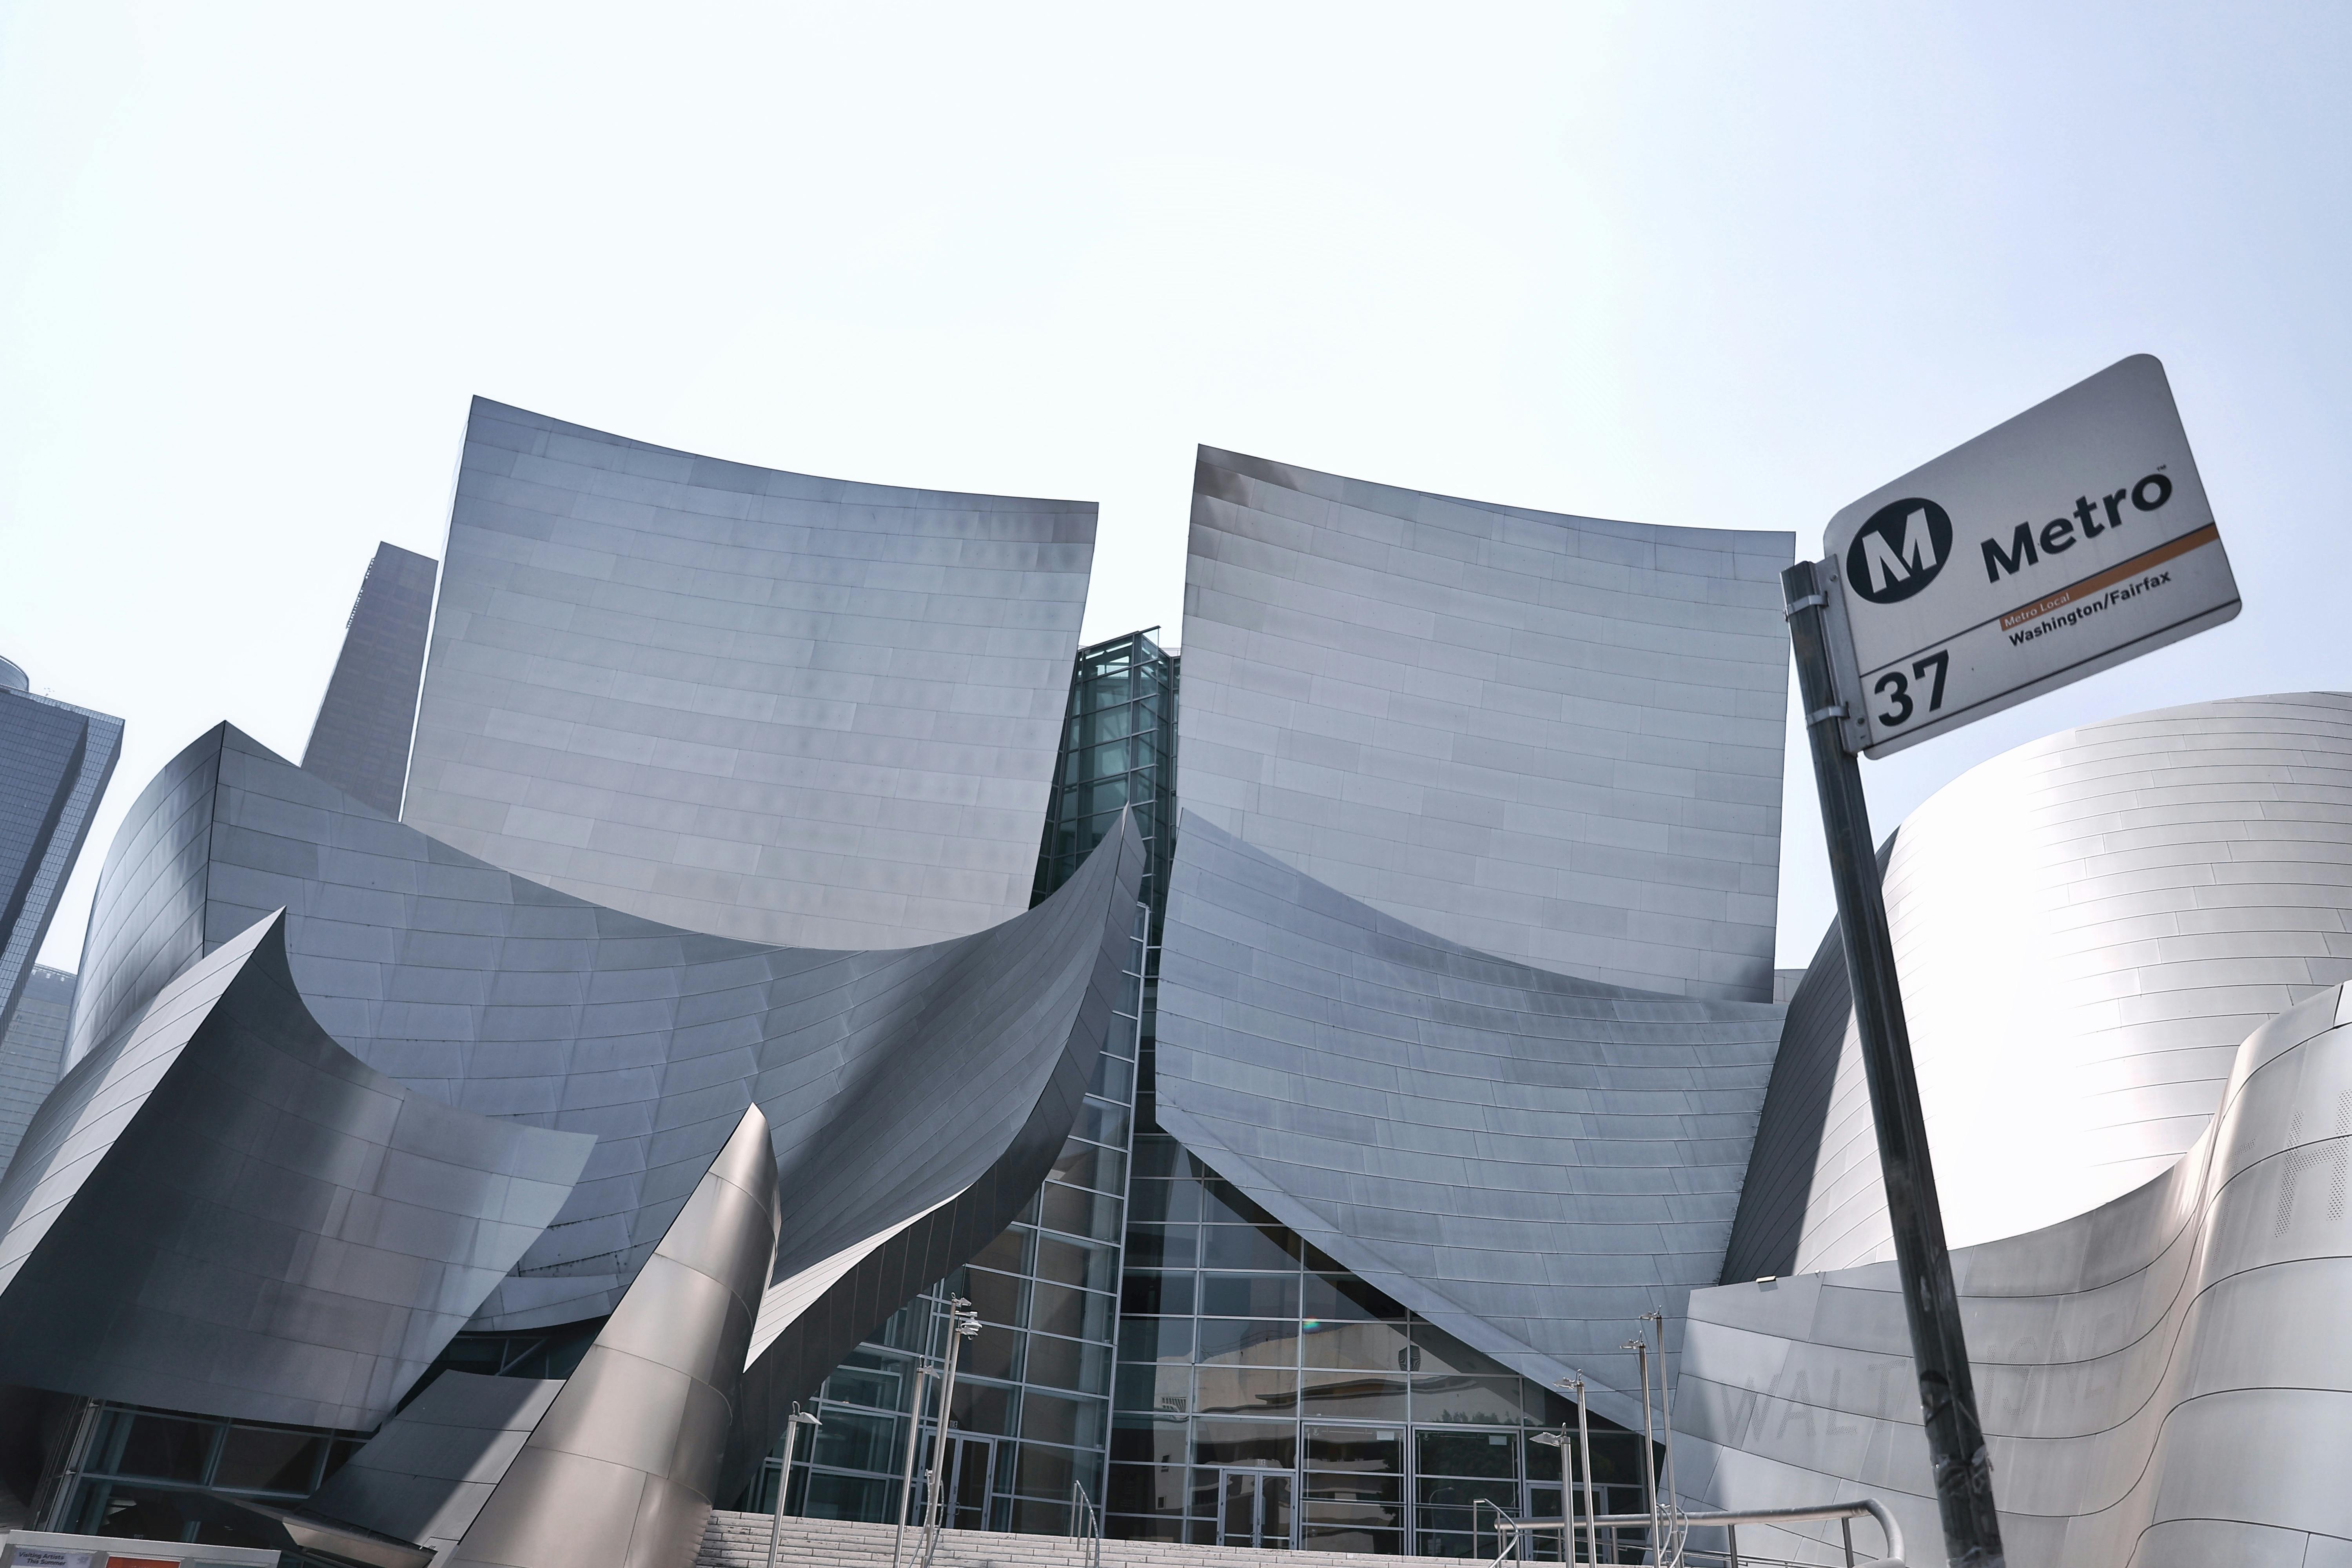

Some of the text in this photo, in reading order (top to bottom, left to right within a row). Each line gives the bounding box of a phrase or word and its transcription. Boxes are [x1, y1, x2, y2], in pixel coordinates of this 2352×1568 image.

[1862, 507, 1937, 593] M
[1980, 473, 2172, 583] Metro
[2004, 592, 2071, 627] Metro Local
[2009, 571, 2172, 646] Washington/Fairfax
[1874, 649, 1949, 726] 37
[1719, 1302, 2141, 1443] WALT ISNEY
